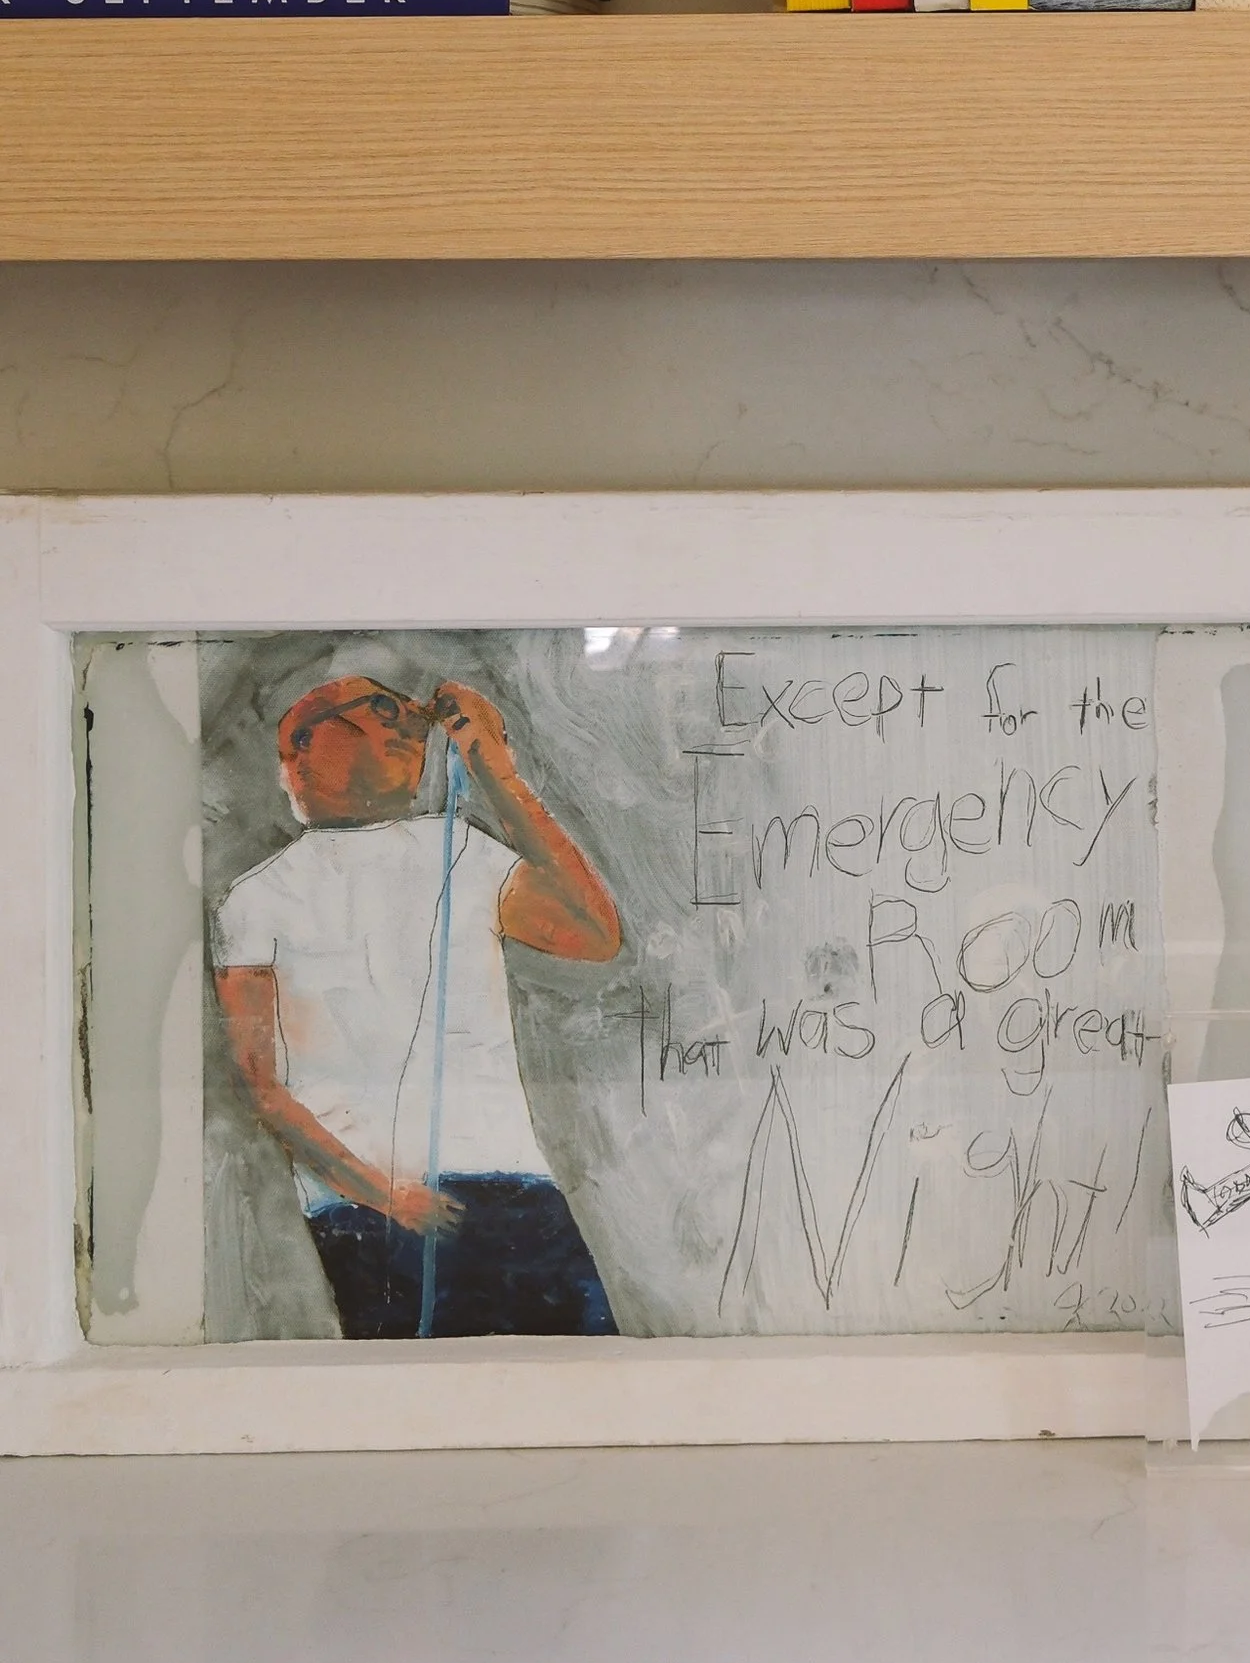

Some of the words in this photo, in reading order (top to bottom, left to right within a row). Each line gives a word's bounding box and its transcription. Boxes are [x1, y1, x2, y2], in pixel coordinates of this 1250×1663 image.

[715, 650, 944, 743] Except
[983, 662, 1038, 736] for
[1070, 677, 1147, 736] the
[682, 739, 1138, 910] Emergency
[756, 998, 876, 1059] was
[920, 990, 966, 1050] a
[996, 987, 1163, 1096] great
